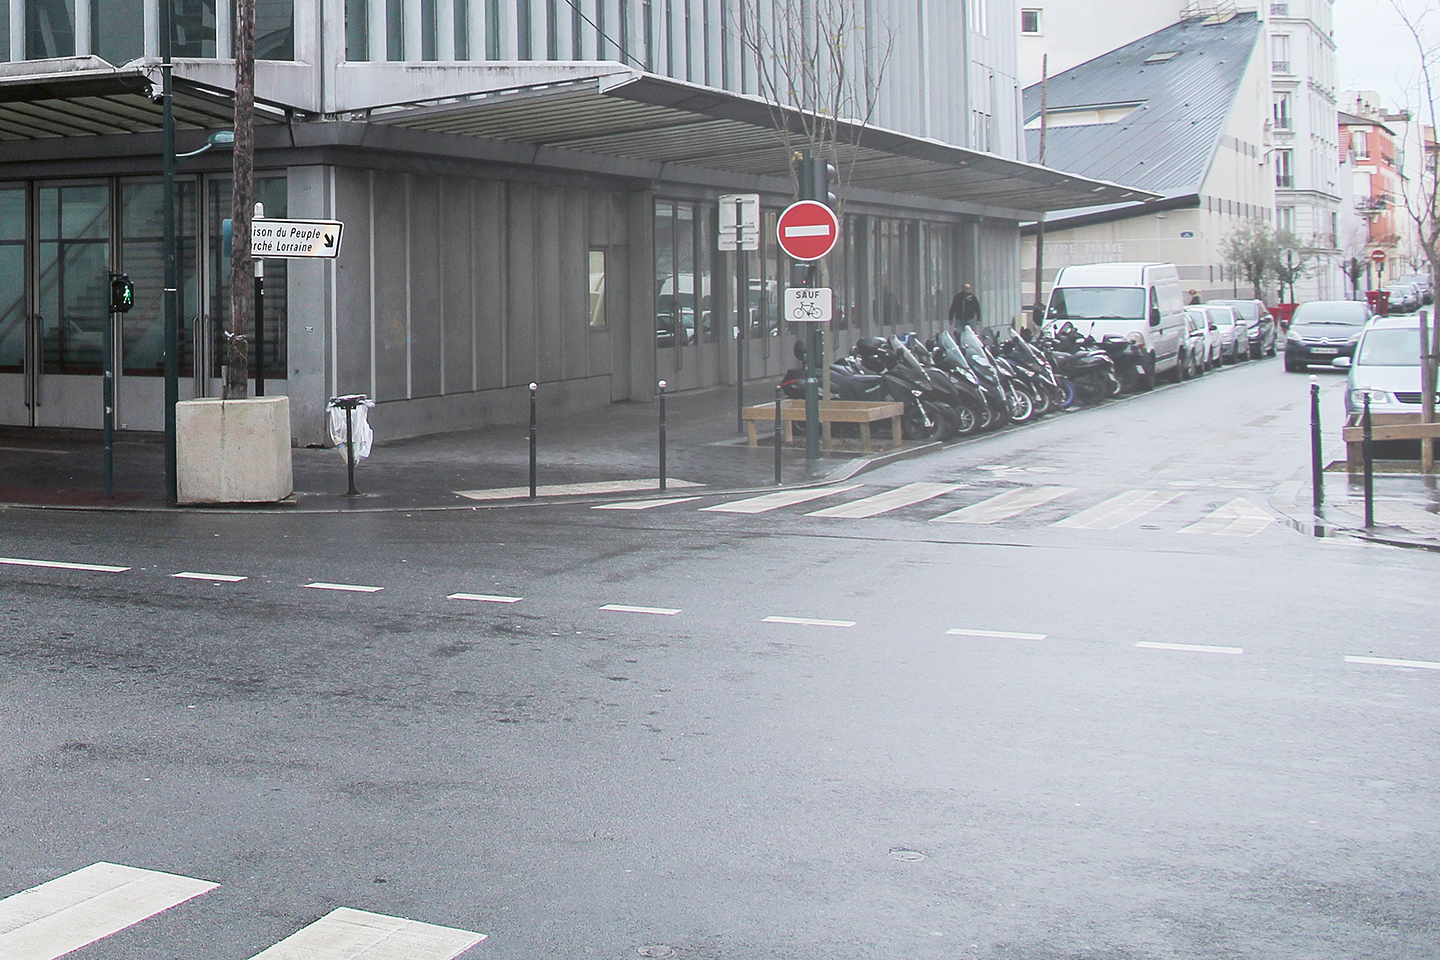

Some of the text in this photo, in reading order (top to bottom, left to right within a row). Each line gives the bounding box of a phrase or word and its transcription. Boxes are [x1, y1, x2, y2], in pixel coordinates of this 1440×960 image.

[253, 226, 321, 241] ison du Peuple
[253, 241, 313, 252] rché Lorraine
[1085, 242, 1126, 253] DAME
[795, 290, 820, 299] SAUF
